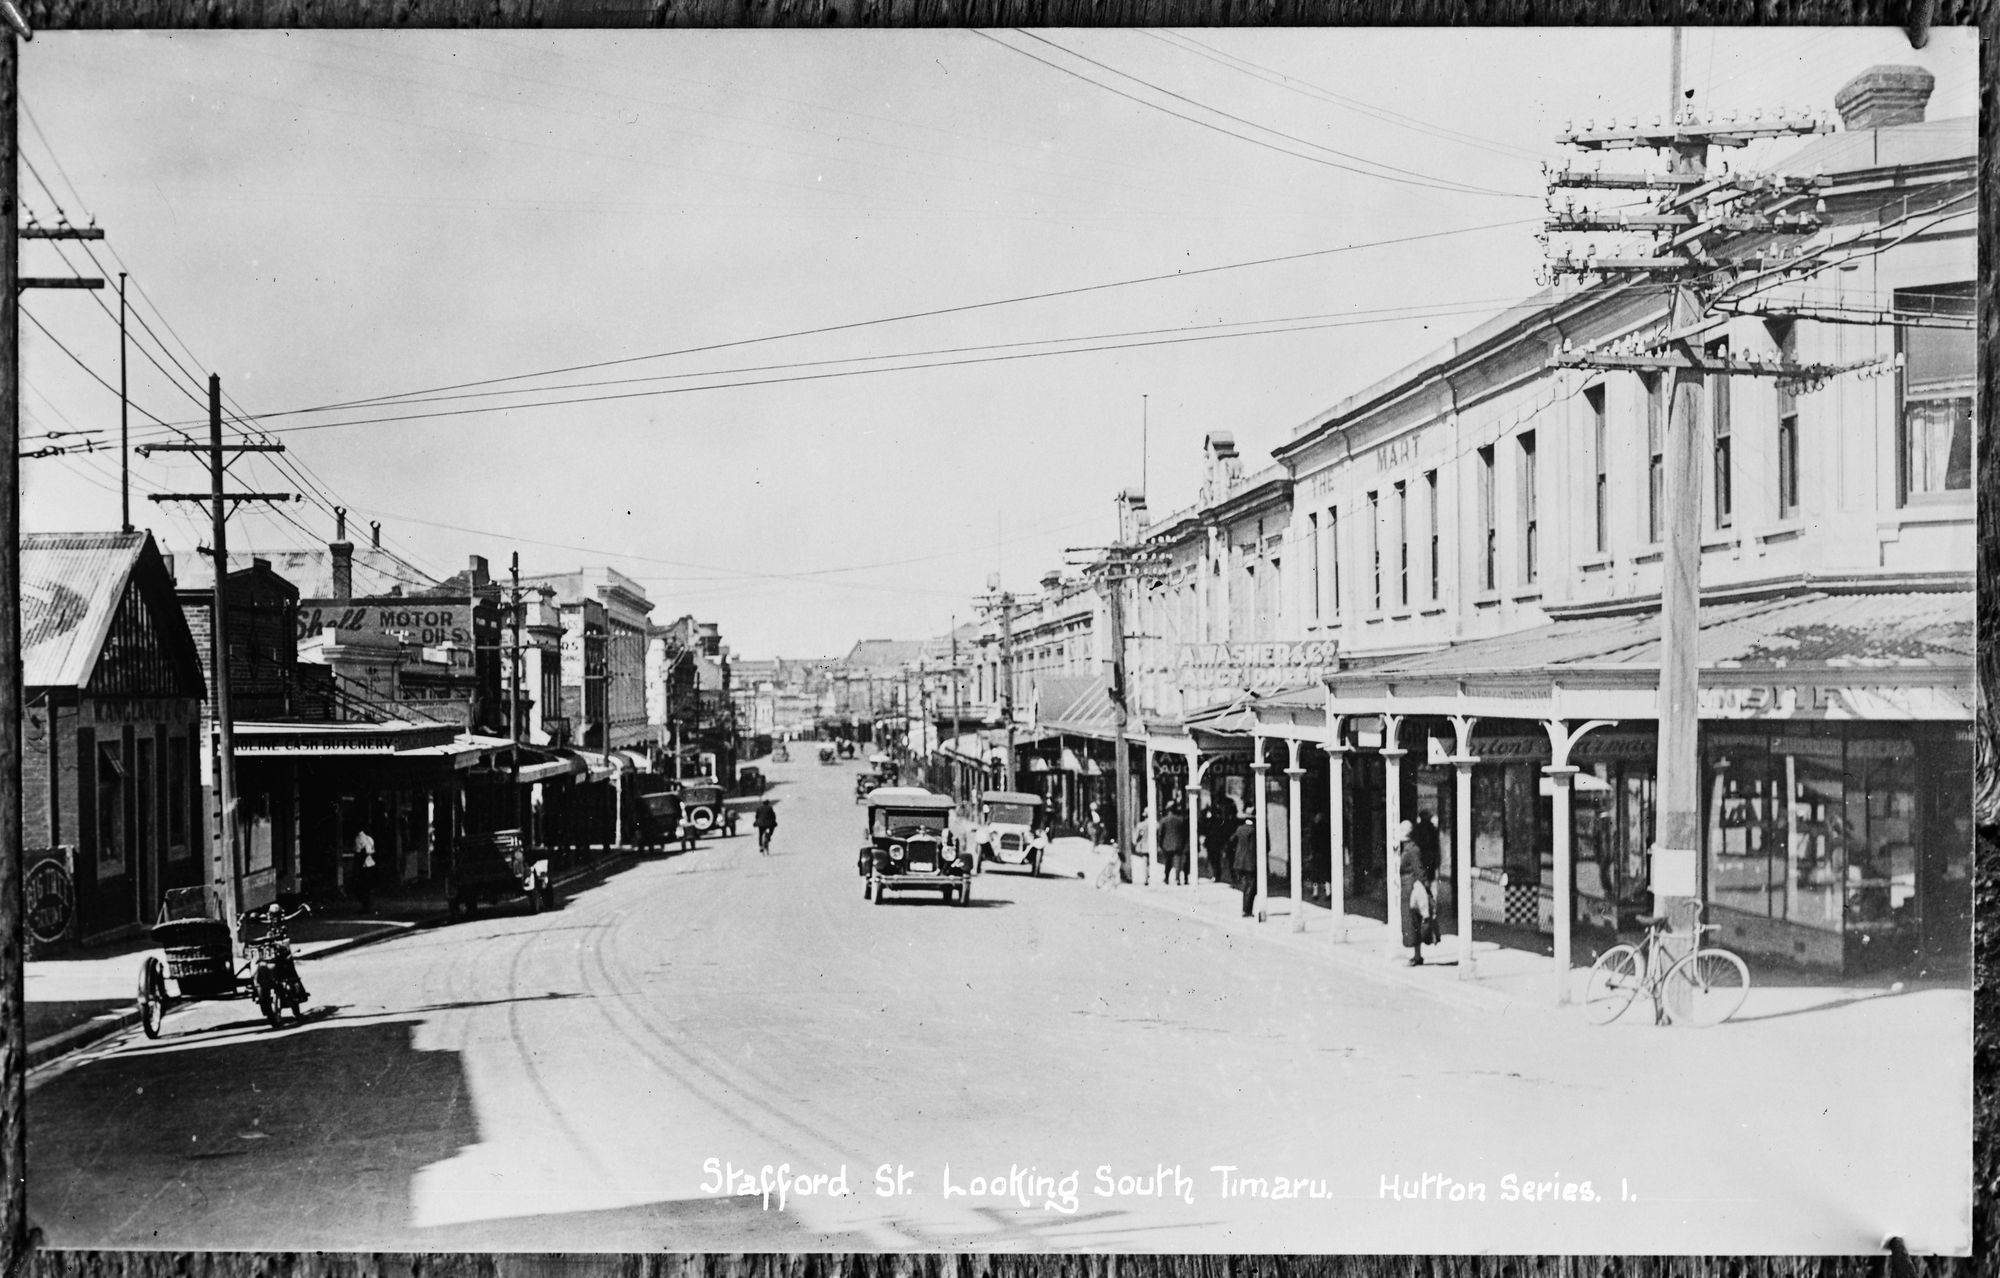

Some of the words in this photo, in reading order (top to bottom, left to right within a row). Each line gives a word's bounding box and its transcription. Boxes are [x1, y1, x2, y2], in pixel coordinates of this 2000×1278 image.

[1376, 434, 1421, 473] MART
[297, 608, 367, 640] Shell
[379, 610, 454, 628] MOTOR
[285, 738, 319, 751] CASH
[323, 736, 394, 750] BUTCHERY
